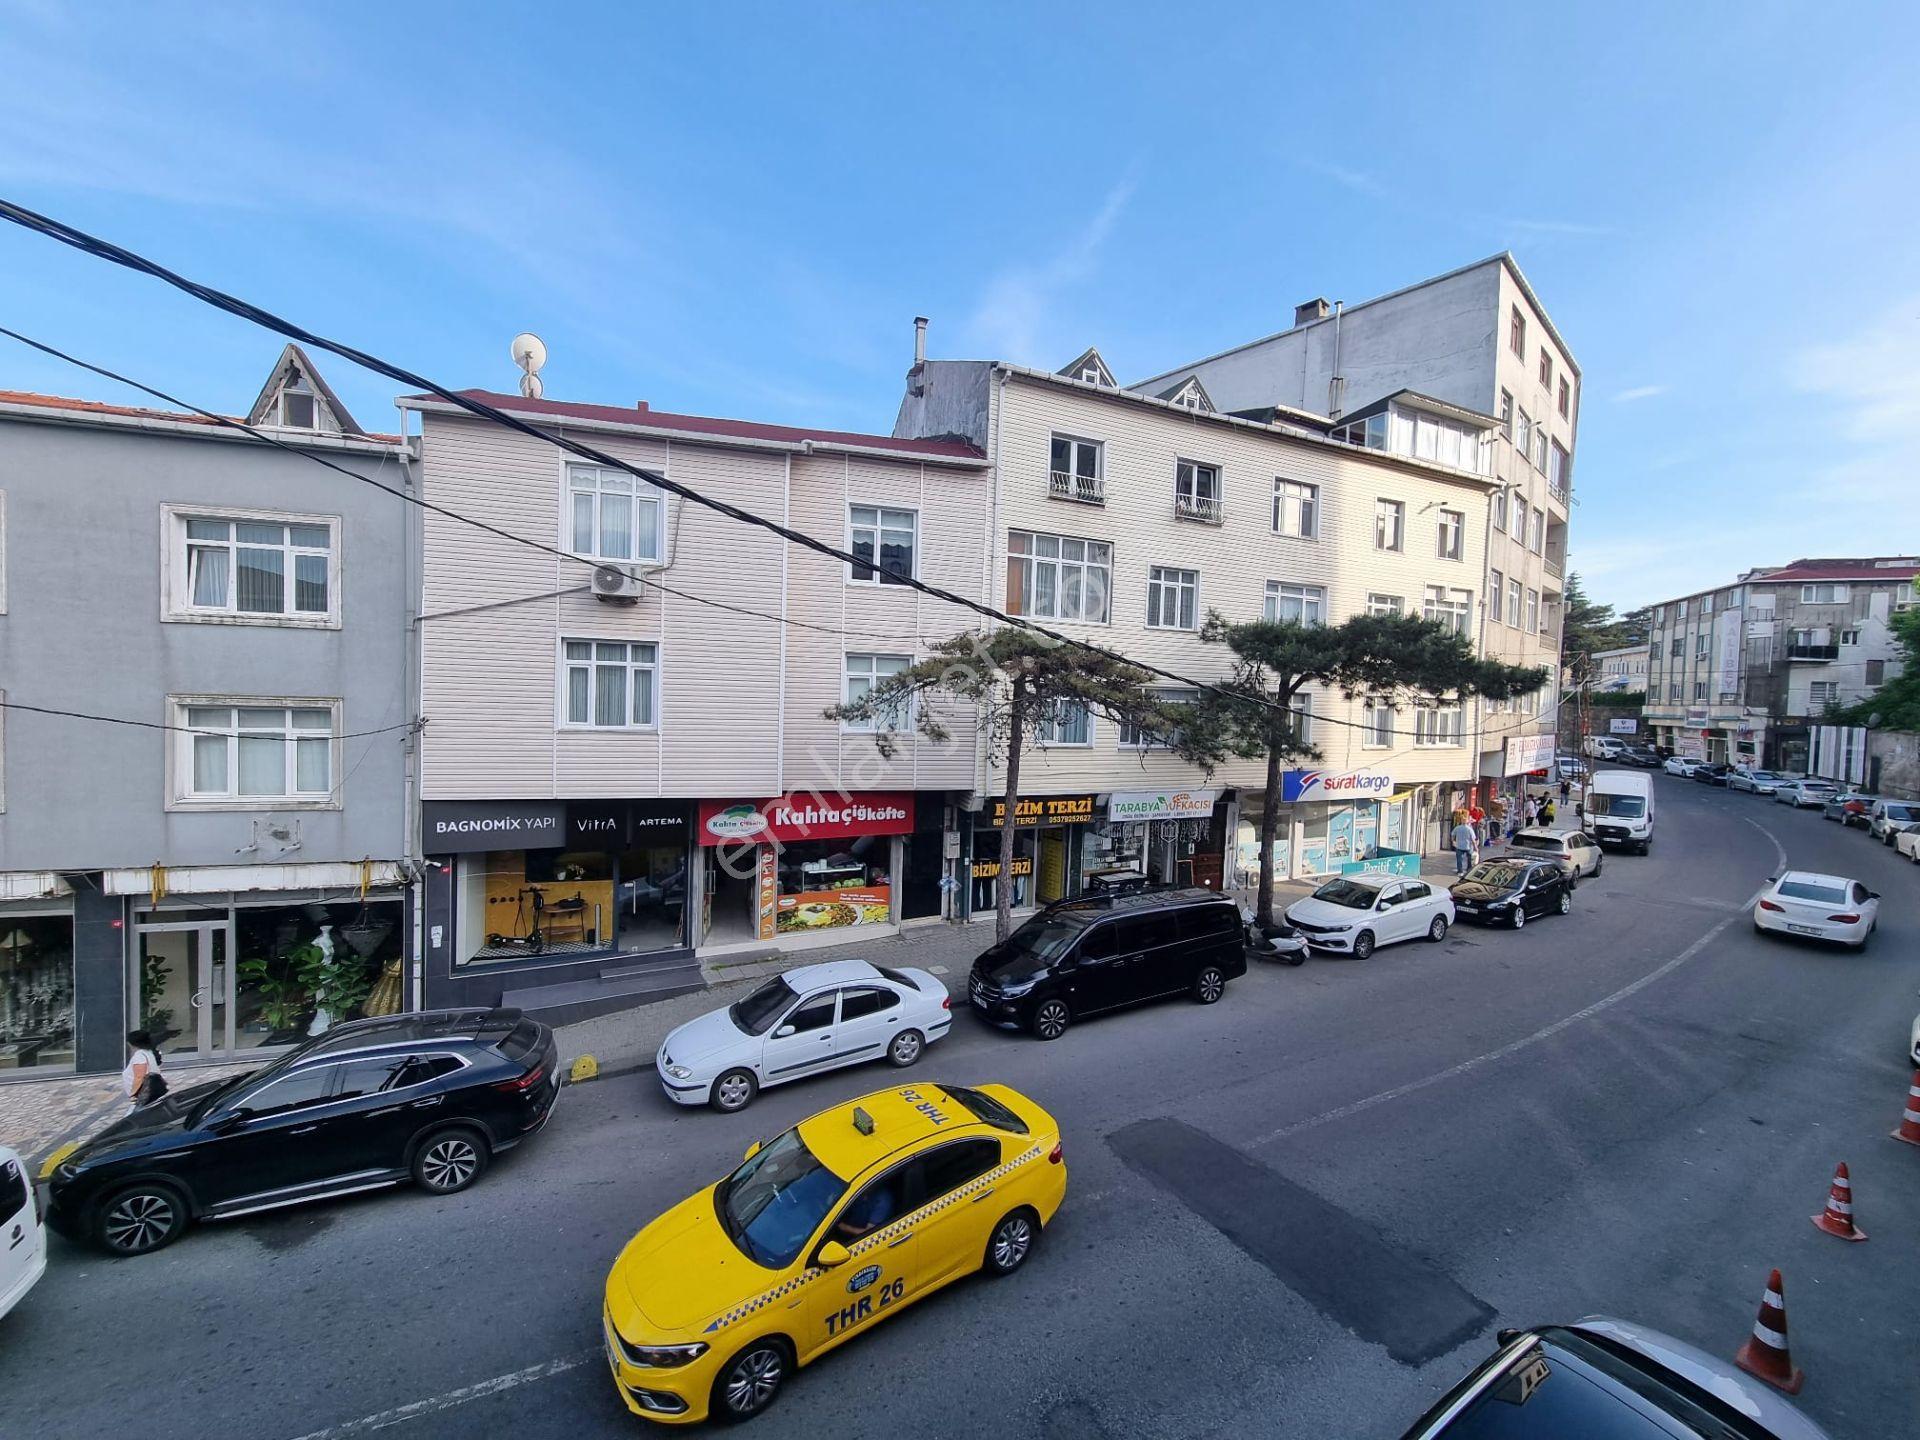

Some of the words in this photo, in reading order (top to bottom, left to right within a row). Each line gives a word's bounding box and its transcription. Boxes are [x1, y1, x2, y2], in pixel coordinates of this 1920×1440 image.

[994, 800, 1043, 816] BZİM
[1048, 797, 1092, 814] TERZİ
[1115, 802, 1160, 813] TARABYA
[436, 816, 521, 834] BAGNOMİX
[524, 817, 556, 829] YAPI
[577, 818, 616, 831] VitrA
[639, 817, 682, 826] ARTEMA
[1015, 816, 1037, 825] TERZİ
[1010, 858, 1031, 875] ERZİ
[899, 1089, 923, 1103] 26
[915, 1102, 950, 1126] THR
[825, 1294, 873, 1336] THR
[880, 1276, 904, 1307] 26
